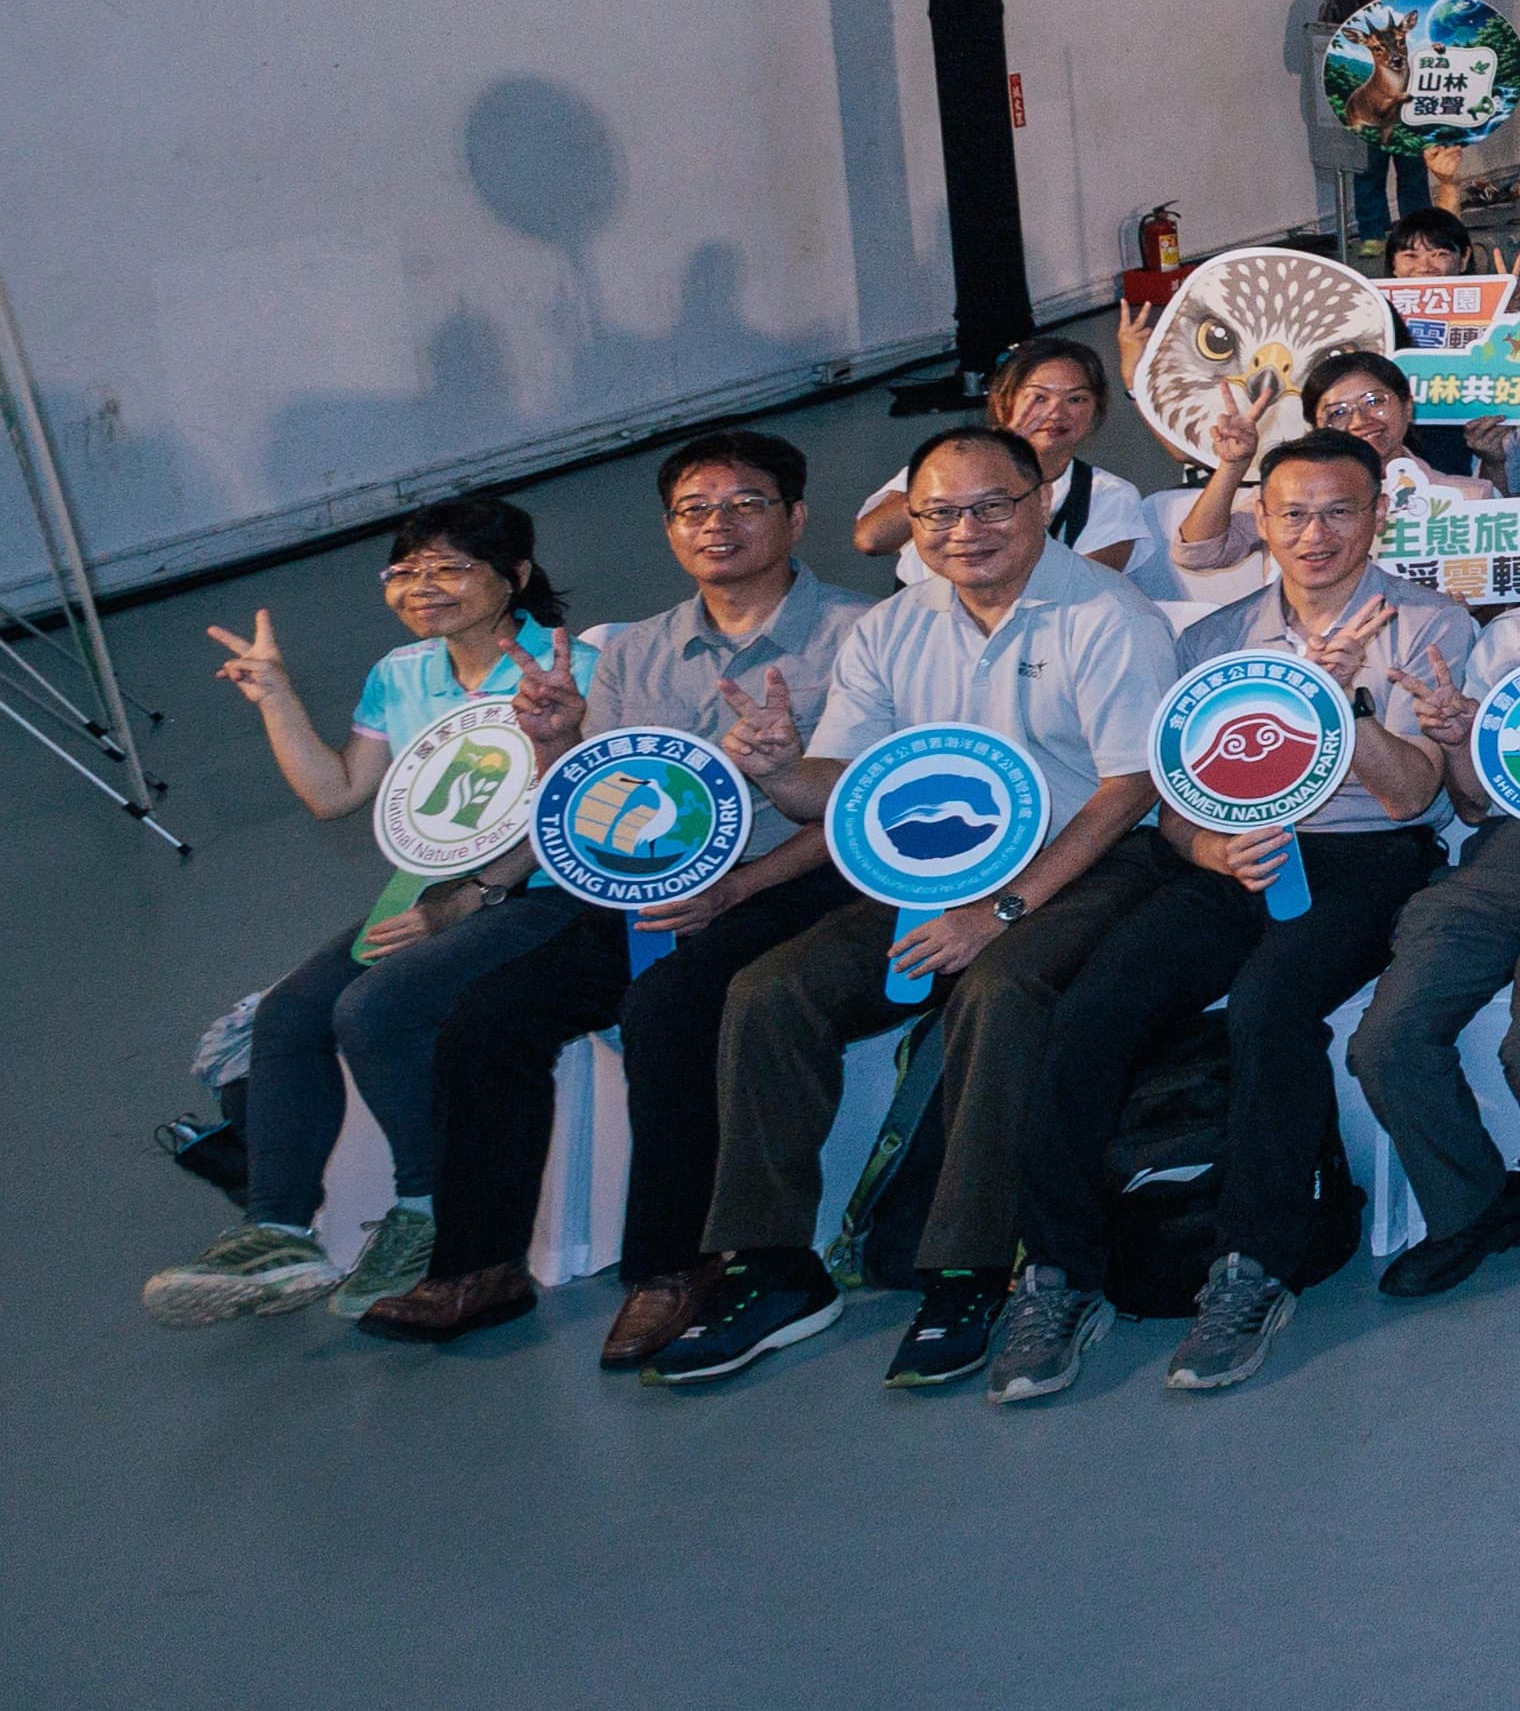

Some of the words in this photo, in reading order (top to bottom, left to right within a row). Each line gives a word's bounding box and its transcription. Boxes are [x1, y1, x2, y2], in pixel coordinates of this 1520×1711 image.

[1418, 72, 1468, 93] 山林
[1419, 56, 1449, 69] 我為
[1414, 95, 1465, 116] 發聲
[1388, 286, 1482, 316] 家公園
[1169, 663, 1320, 731] 金門國家公園管理處
[561, 736, 713, 784] 台江國家公園
[1167, 768, 1229, 820] KINMEN
[1230, 774, 1325, 821] NATIONAL
[1316, 728, 1341, 777] PARK
[389, 787, 414, 851] National
[412, 842, 469, 863] Nature
[473, 818, 517, 852] Park
[541, 813, 606, 894] TAIJIANG
[607, 853, 725, 901] NATIONAL
[713, 794, 738, 850] PARK
